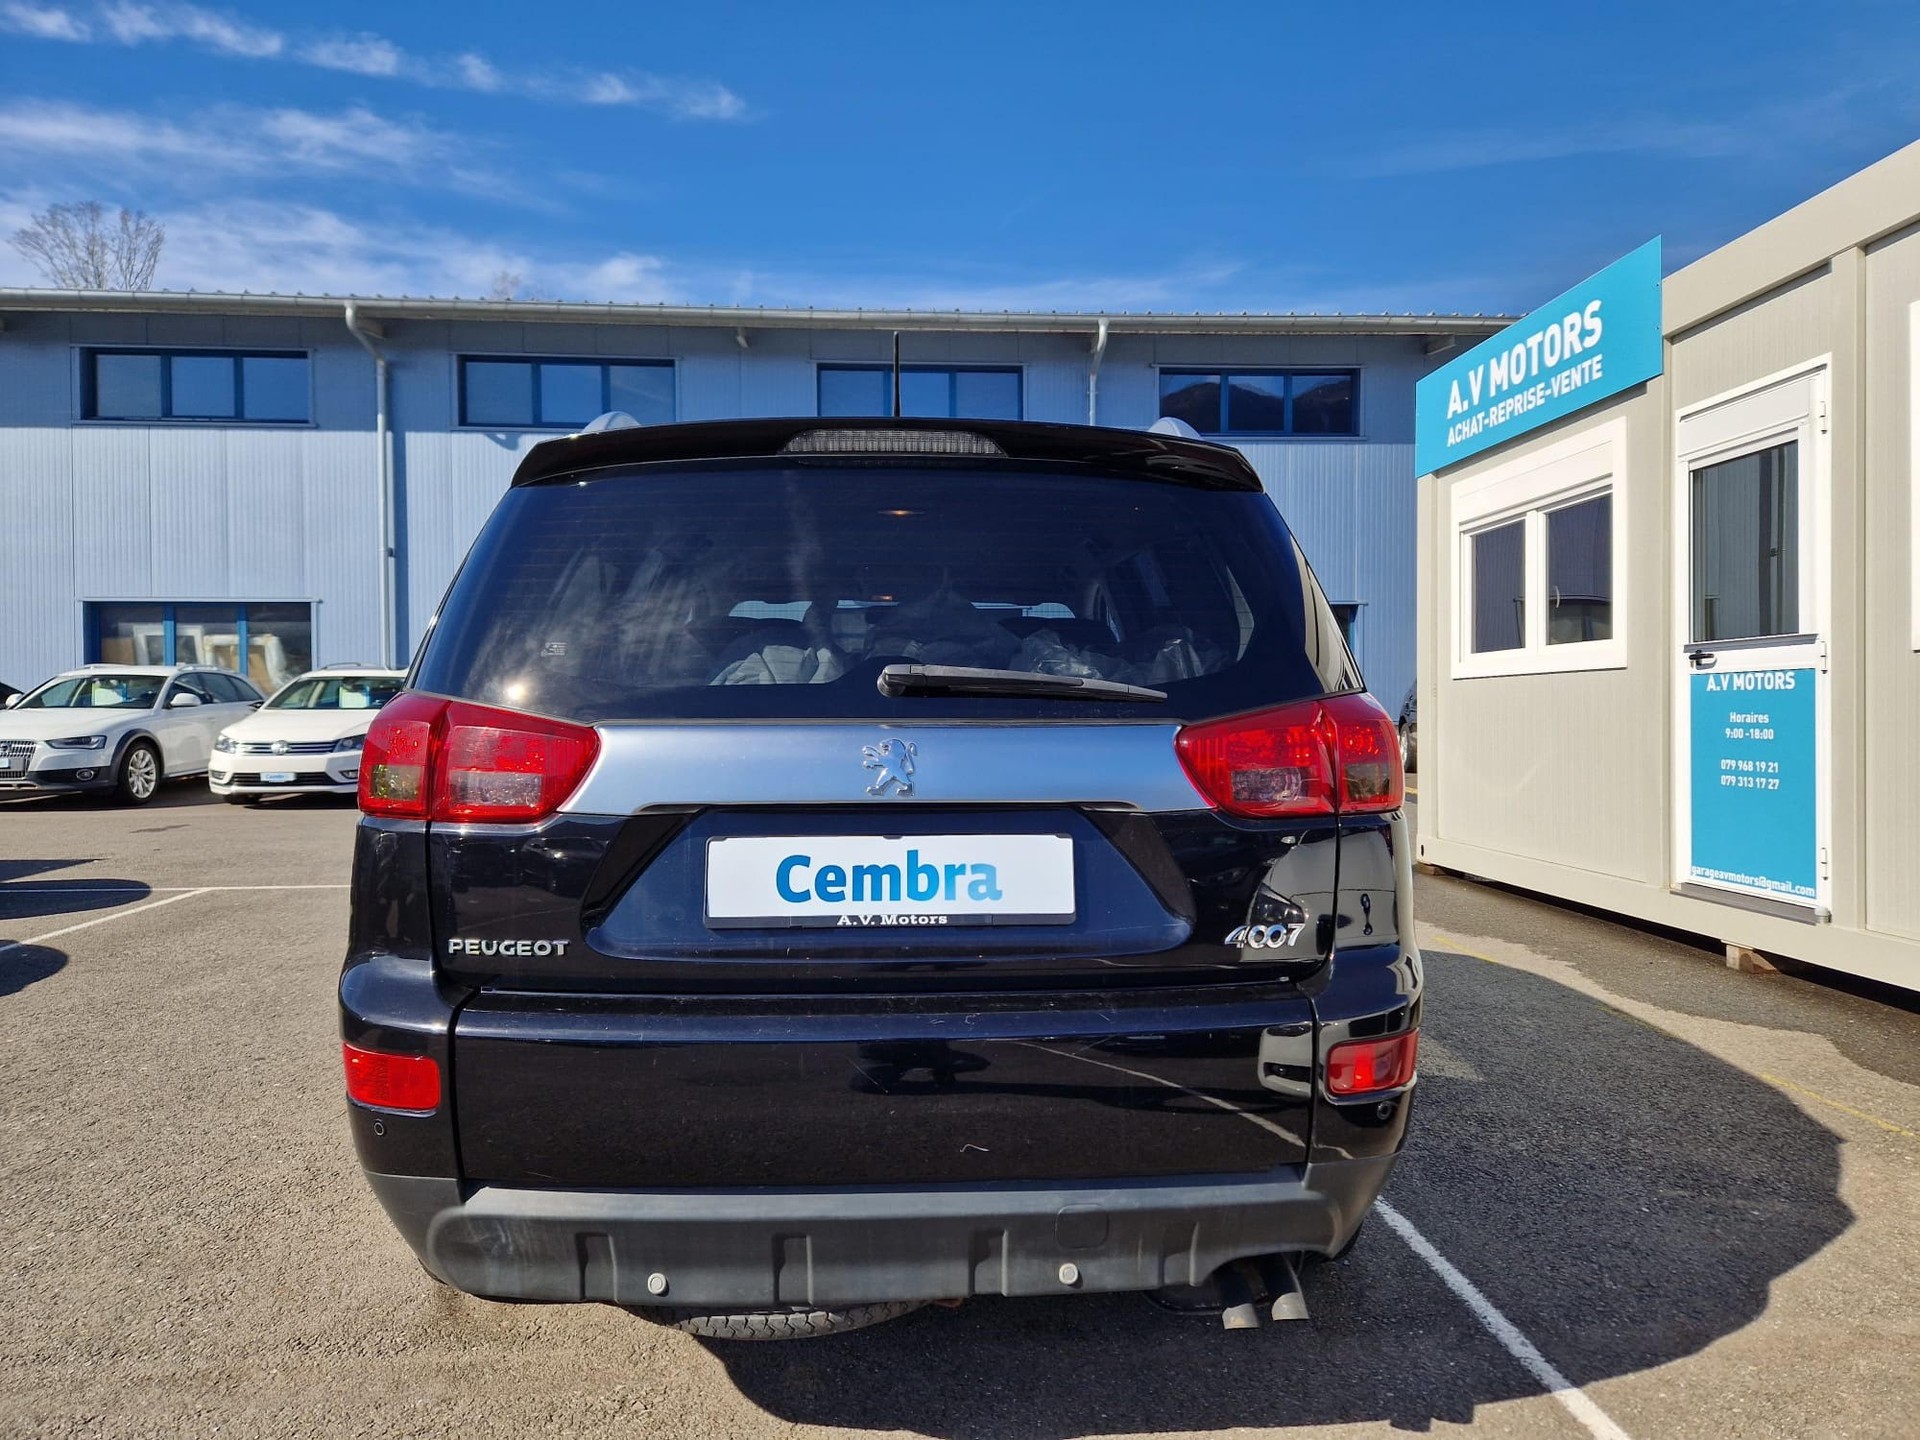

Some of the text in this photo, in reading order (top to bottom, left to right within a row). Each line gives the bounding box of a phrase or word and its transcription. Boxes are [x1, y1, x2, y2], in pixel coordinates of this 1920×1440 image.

[1447, 299, 1603, 420] A.V MOTORS
[1447, 353, 1603, 447] ACHAT-REPRISE-VENTE
[1706, 671, 1795, 691] A.V MOTORS
[1729, 711, 1769, 723] Horaires
[1725, 728, 1743, 738] 9:00
[1720, 759, 1778, 773] 079 968 19 21
[1720, 775, 1779, 789] 079 313 17 27
[775, 849, 1003, 903] Cembra
[836, 914, 948, 927] A.V. Motors
[1224, 922, 1306, 949] 4007
[447, 938, 570, 957] PEUGEOT
